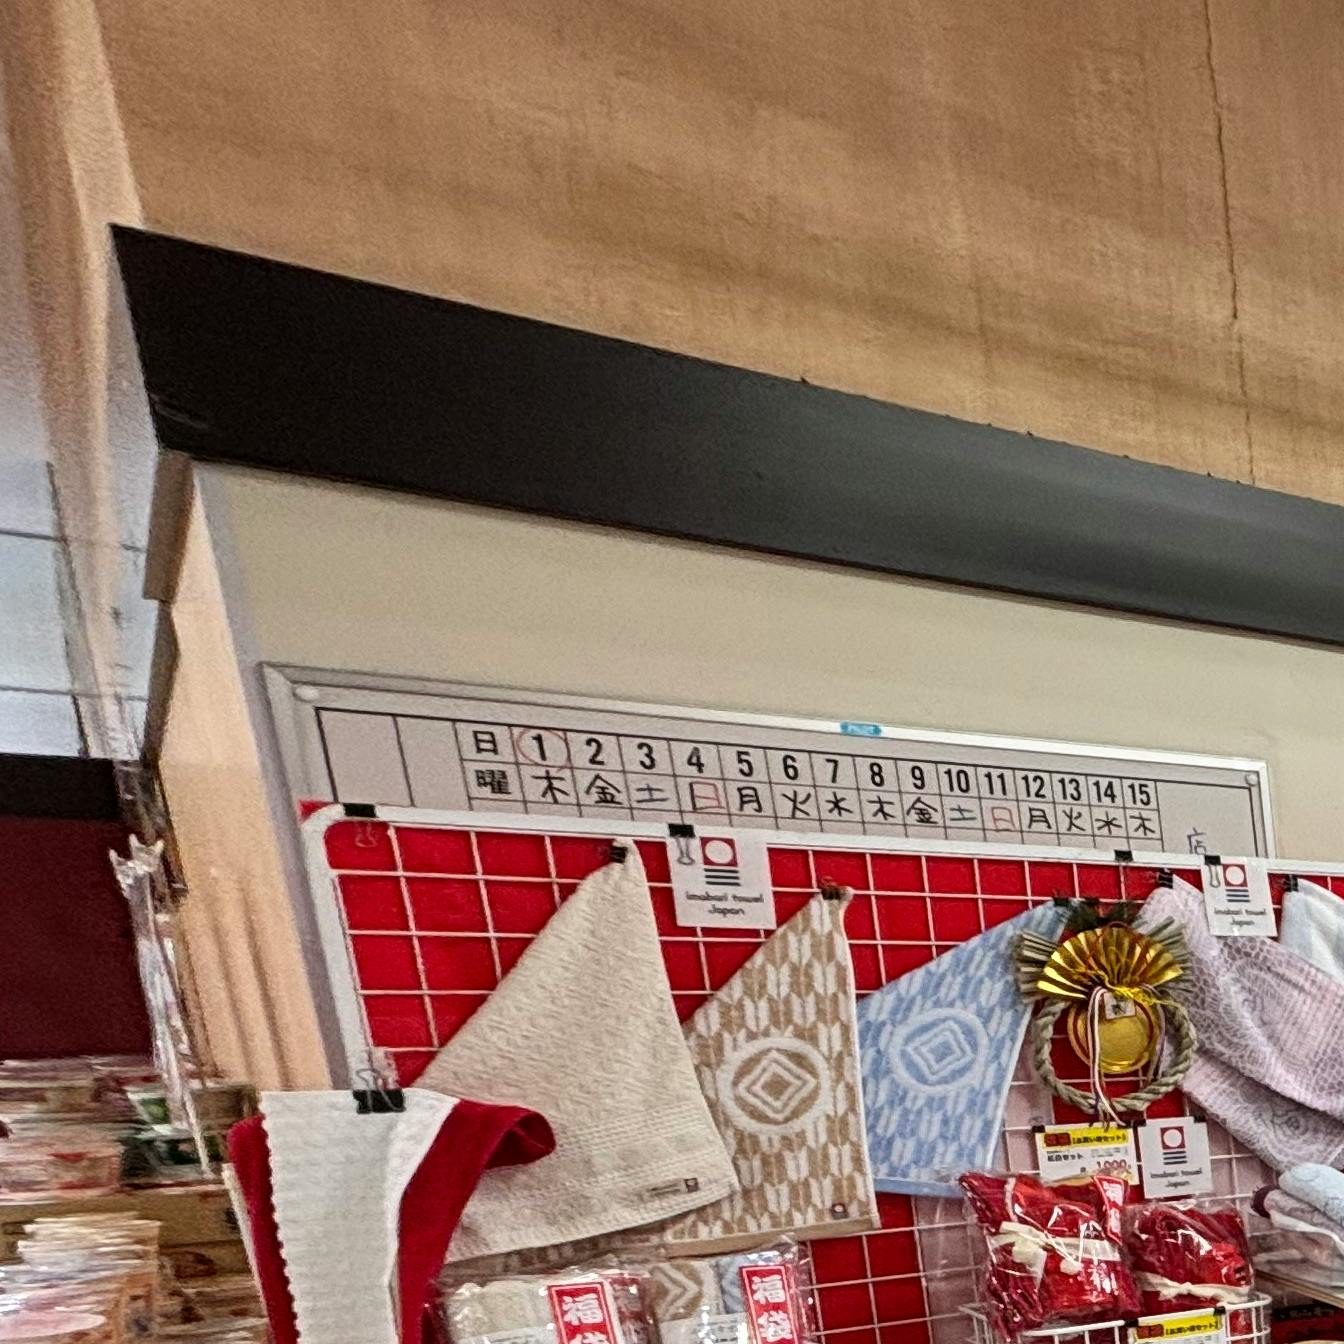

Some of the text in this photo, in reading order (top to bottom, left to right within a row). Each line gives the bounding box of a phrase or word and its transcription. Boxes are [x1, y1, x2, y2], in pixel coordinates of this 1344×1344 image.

[473, 729, 1150, 806] 日 1 2 3 4 5 6 7 8 9 10 11 12 13 14 15
[475, 769, 1156, 837] 曜 木 金 土 日 月 火 水 木 金 土 日 月 火 水 木
[751, 1273, 793, 1343] 福袋
